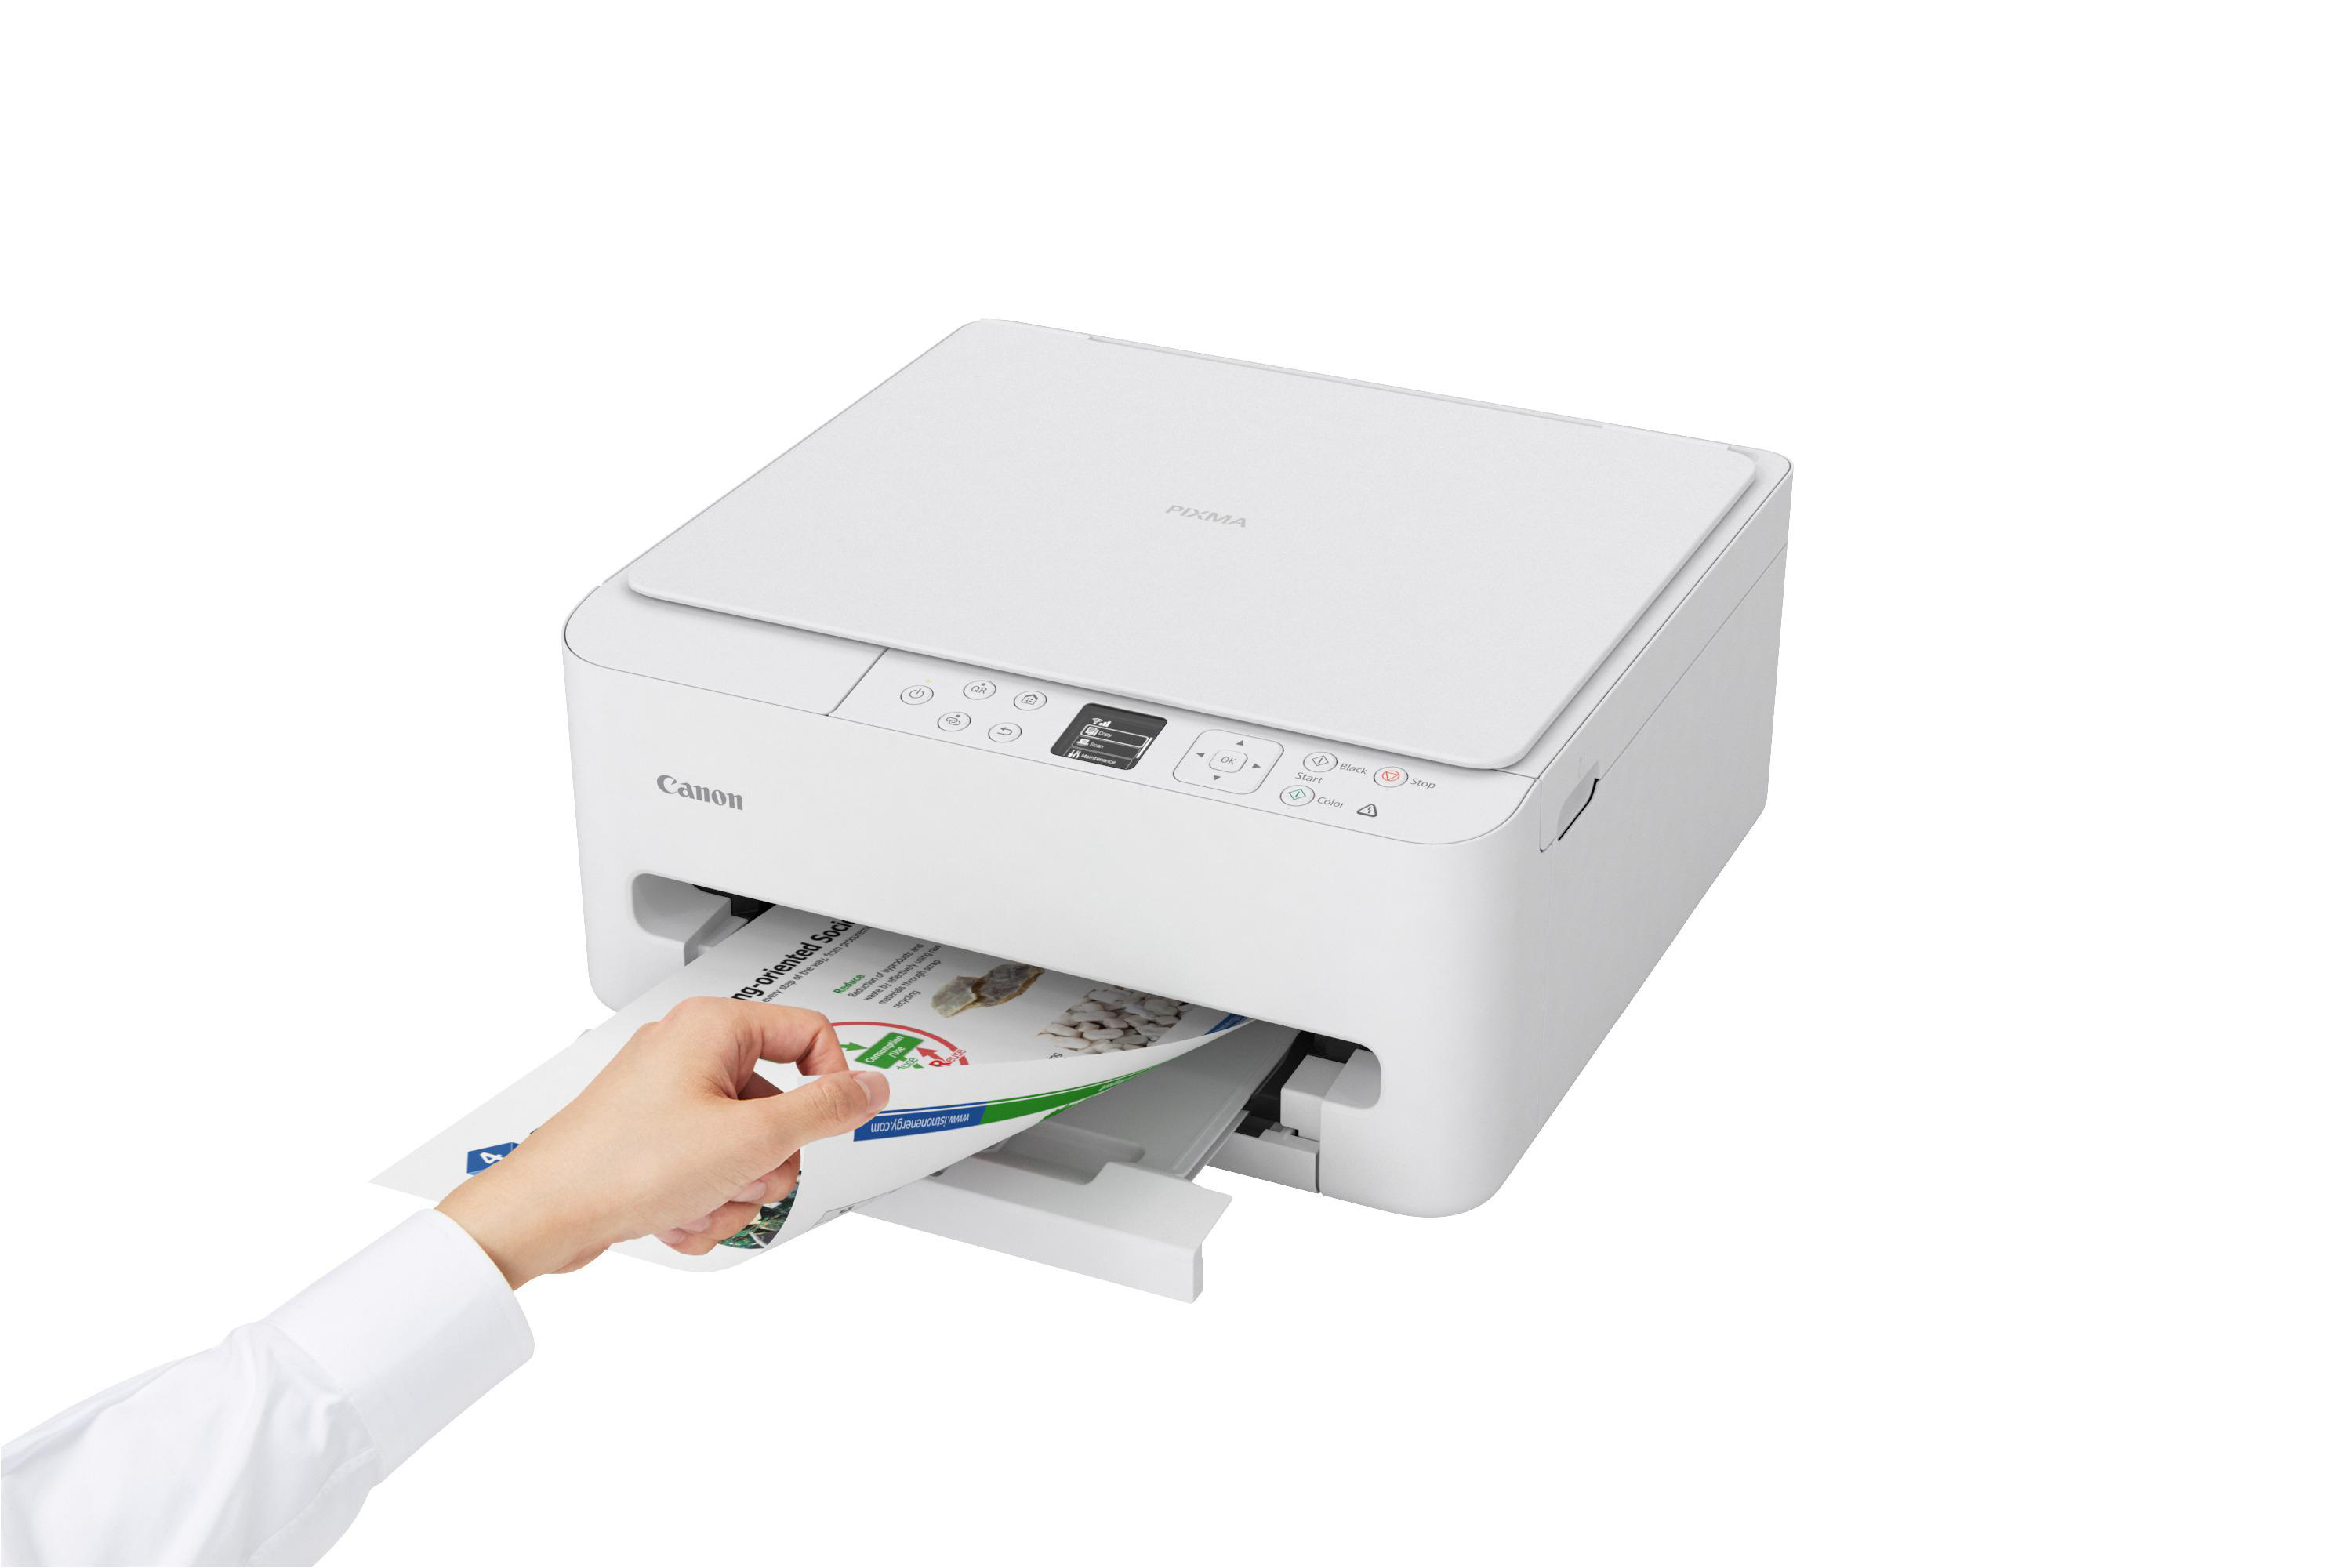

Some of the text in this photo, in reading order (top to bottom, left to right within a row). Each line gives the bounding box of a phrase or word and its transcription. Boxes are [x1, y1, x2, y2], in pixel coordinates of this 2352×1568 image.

[1165, 504, 1246, 528] PIXMA
[971, 685, 987, 695] QR
[1080, 753, 1116, 765] Maintenance
[1221, 756, 1237, 765] OK
[1339, 762, 1368, 775] Black
[1294, 771, 1323, 784] Start
[1410, 777, 1436, 790] Stop
[657, 775, 743, 810] Canon
[1317, 797, 1345, 809] Color
[762, 989, 783, 1003] every
[779, 980, 797, 990] step
[823, 946, 843, 957] from
[848, 977, 878, 997] Reduction
[880, 951, 913, 973] byproducts
[910, 943, 924, 952] and
[863, 989, 884, 1001] waste
[887, 963, 918, 983] effectively
[914, 953, 933, 964] using
[928, 945, 941, 953] raw
[833, 974, 865, 994] Reduce
[878, 960, 941, 1004] materials through scrap
[893, 990, 921, 1008] recycling
[865, 1036, 904, 1063] Consumption
[871, 1113, 970, 1133] www.istnonenergy.com
[479, 1152, 503, 1164] 4
